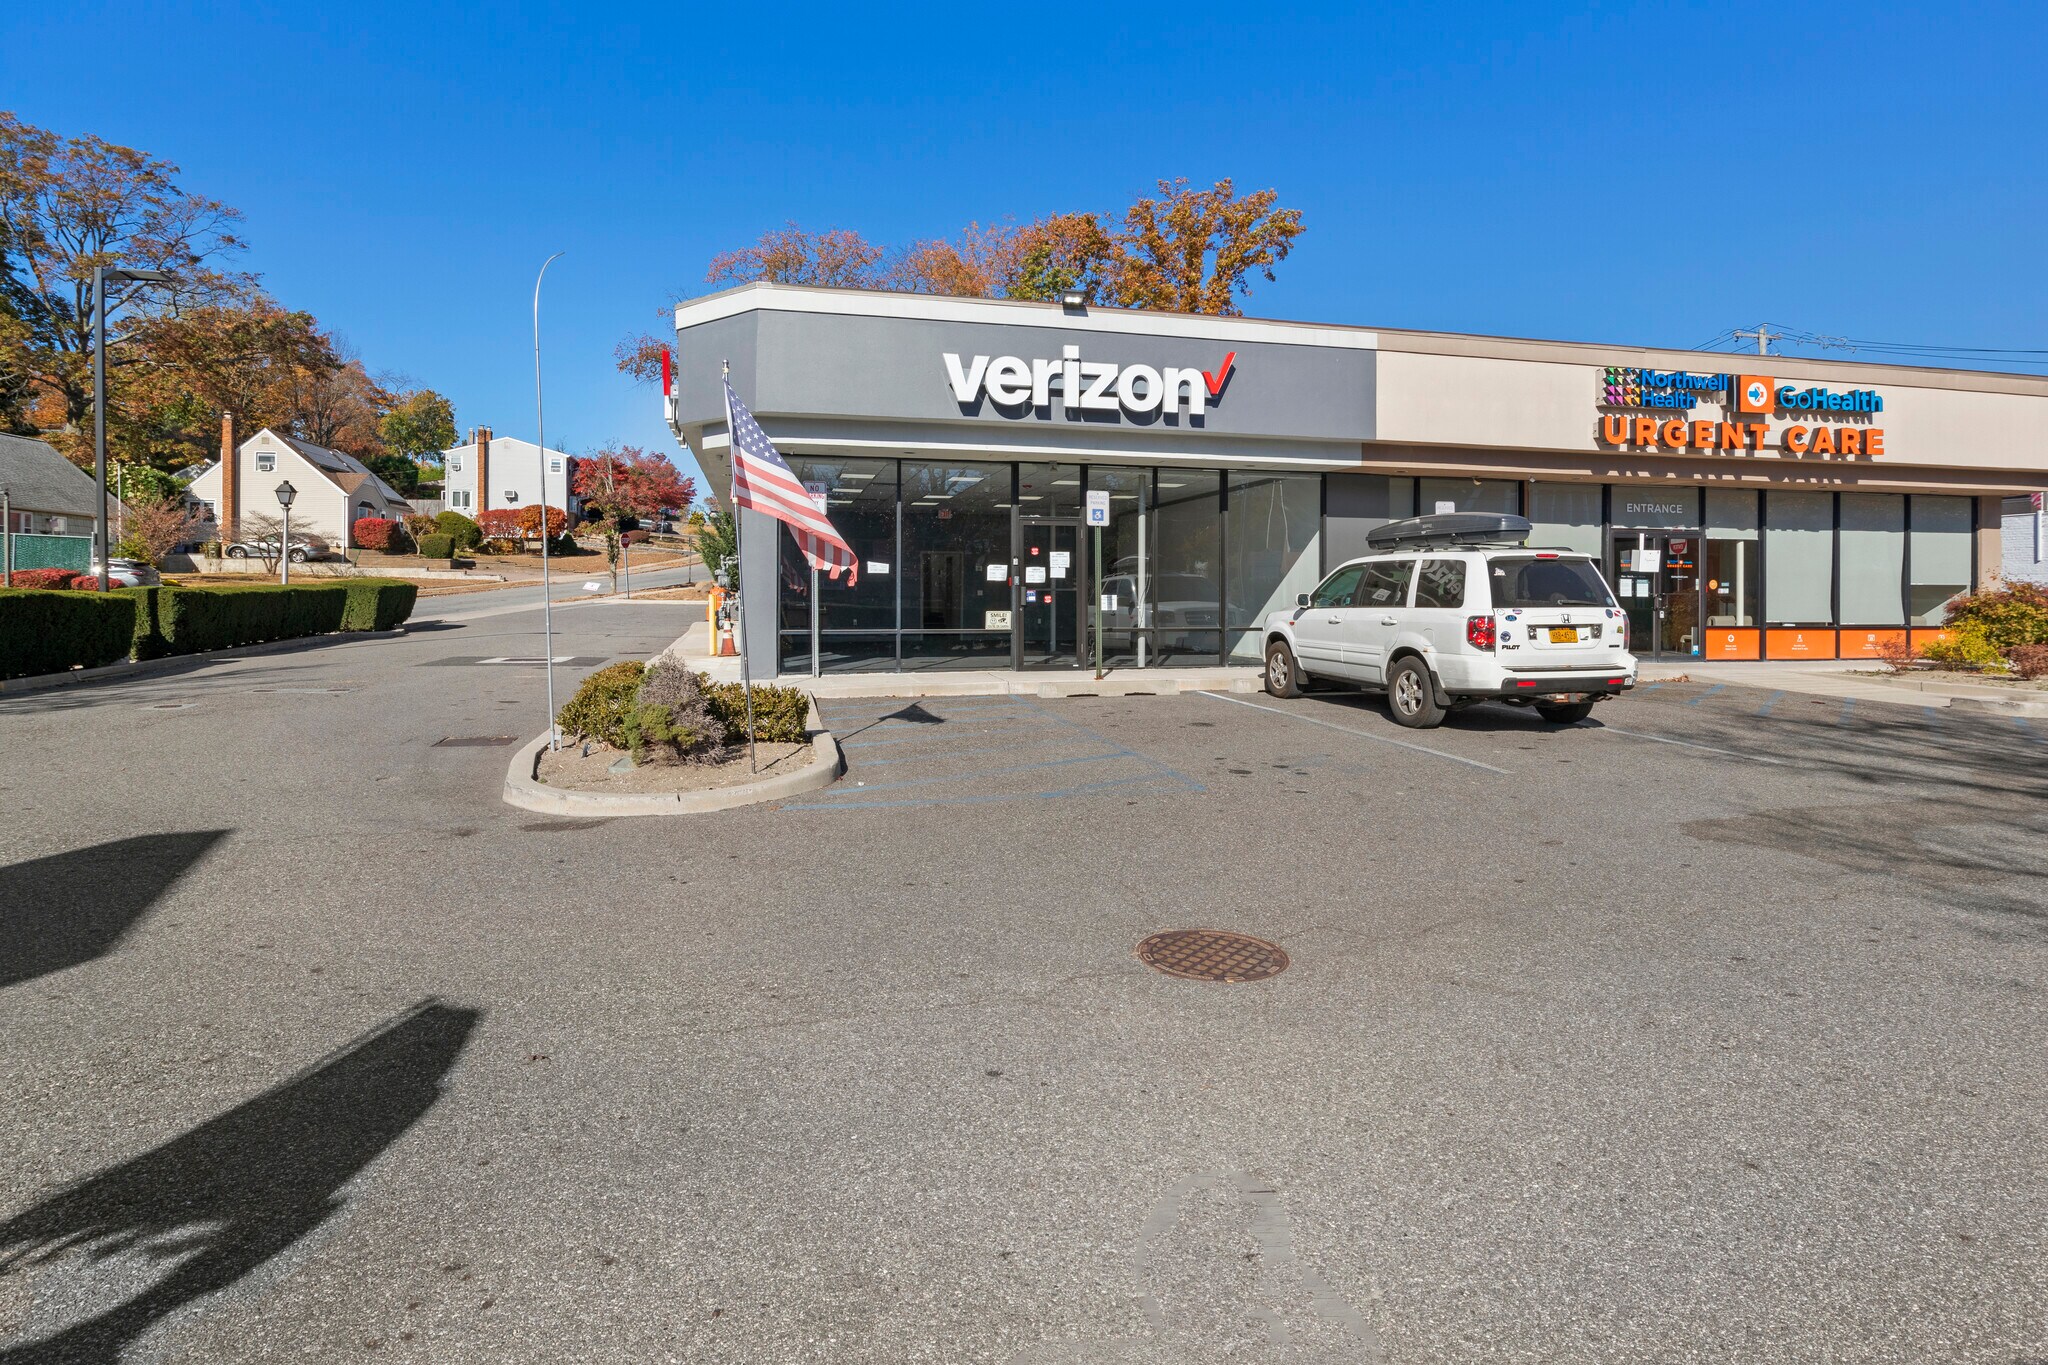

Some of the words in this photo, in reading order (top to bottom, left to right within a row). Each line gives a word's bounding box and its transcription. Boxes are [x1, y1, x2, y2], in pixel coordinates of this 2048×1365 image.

[943, 345, 1206, 415] verizon
[1641, 370, 1728, 391] Northwell
[1641, 390, 1697, 409] Health
[1779, 385, 1884, 412] GoHealth
[1604, 415, 1770, 451] URGENT
[1787, 425, 1885, 455] CARE
[1626, 503, 1683, 514] ENTRANCE
